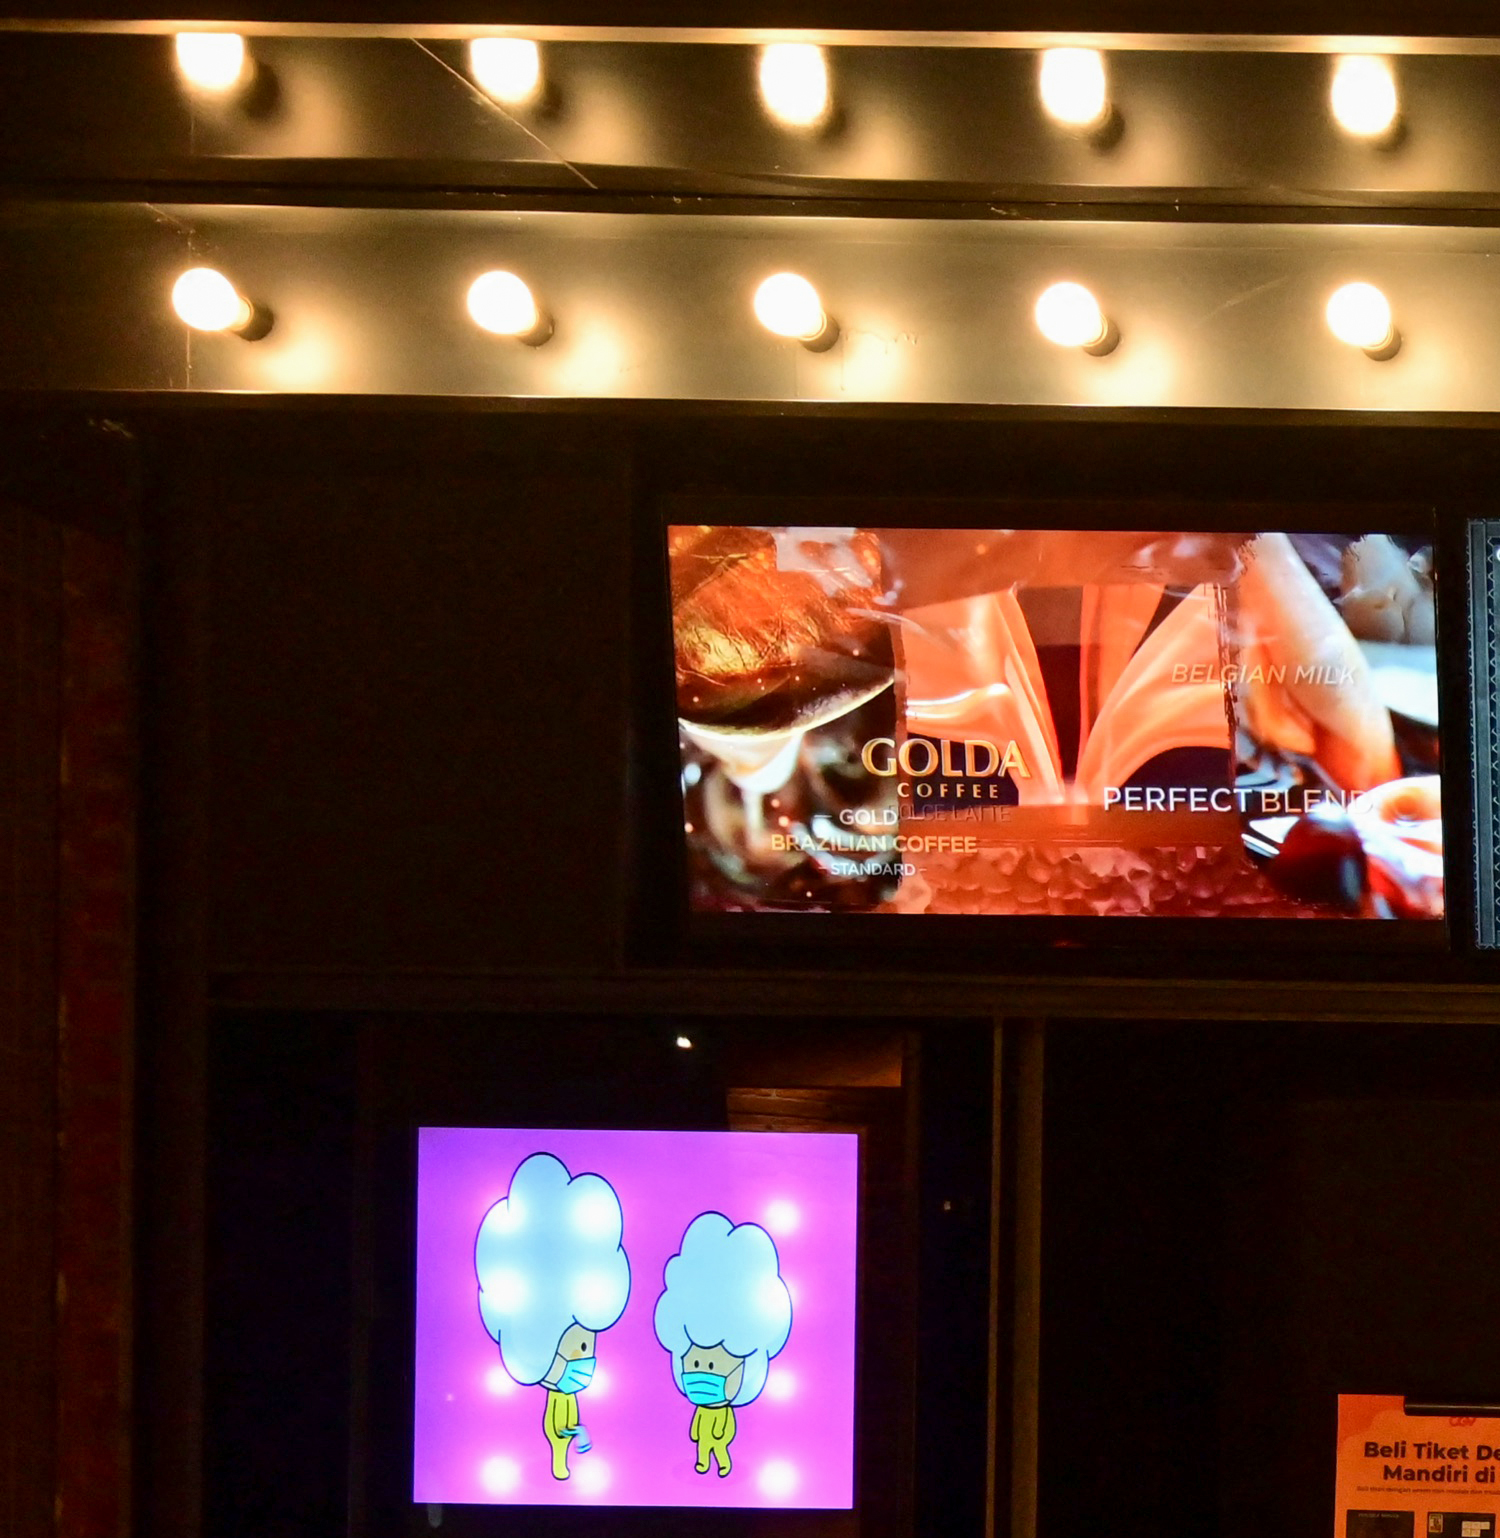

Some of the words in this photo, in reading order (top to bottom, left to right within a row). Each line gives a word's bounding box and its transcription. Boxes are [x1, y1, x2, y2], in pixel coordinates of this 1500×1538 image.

[1171, 662, 1287, 685] BELGIAN
[1294, 664, 1356, 686] MILK
[860, 736, 1032, 780] GOLDA
[896, 782, 1000, 799] COFFEE
[1103, 787, 1249, 813] PERFECT
[1260, 789, 1375, 816] BLEND
[839, 807, 898, 826] GOLD
[771, 834, 888, 853] BRAZILIAN
[892, 834, 978, 854] COFFEE
[829, 861, 917, 878] STANDARD
[1364, 1440, 1407, 1458] Beli
[1413, 1441, 1469, 1460] Tiket
[1383, 1464, 1468, 1483] Mandiri
[1474, 1465, 1496, 1483] di
